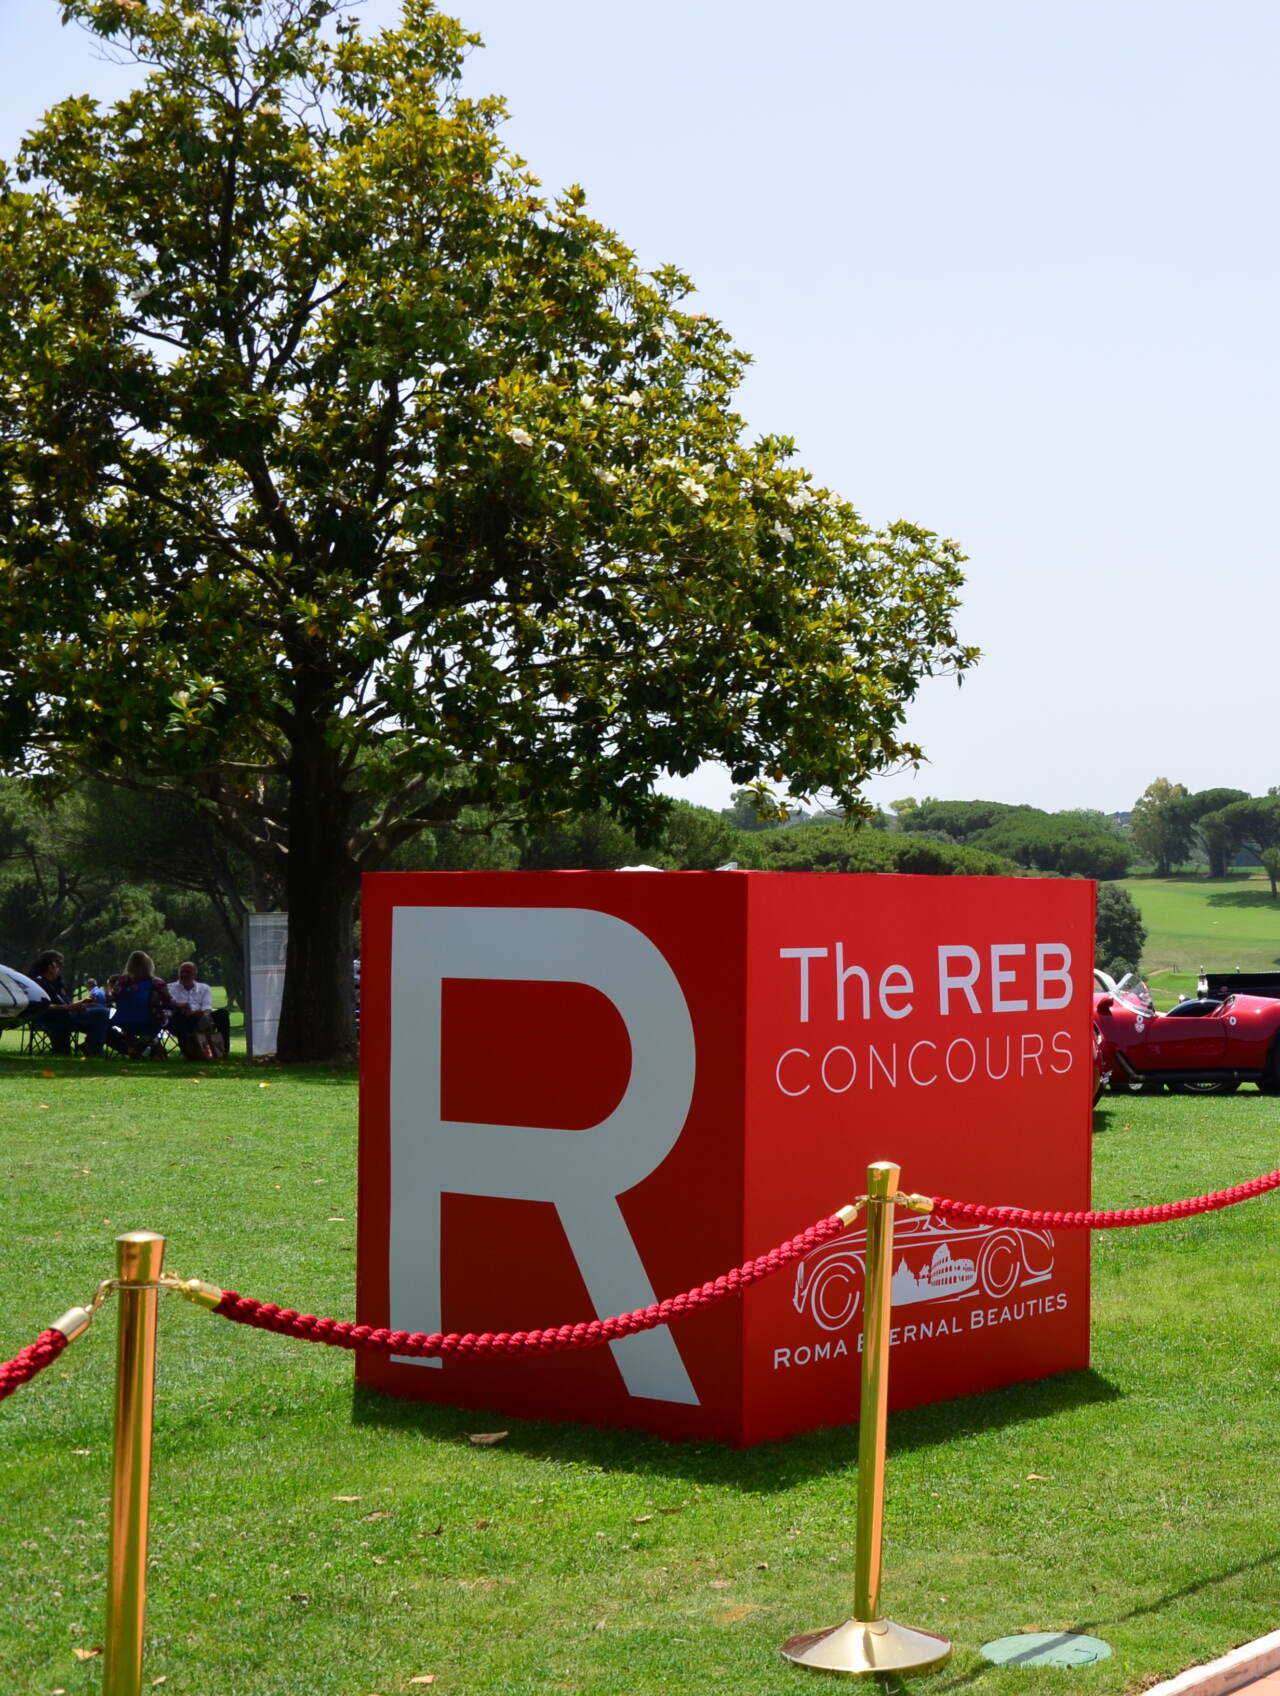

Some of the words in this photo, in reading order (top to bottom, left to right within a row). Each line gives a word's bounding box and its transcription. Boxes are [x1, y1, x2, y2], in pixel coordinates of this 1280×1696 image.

[779, 942, 914, 1022] The
[937, 943, 1074, 1016] REB
[775, 1031, 1073, 1097] CONCOURS
[389, 906, 700, 1405] R
[773, 1339, 848, 1370] ROMA
[857, 1317, 962, 1353] EERNAL
[970, 1293, 1068, 1330] BEAUTIES
